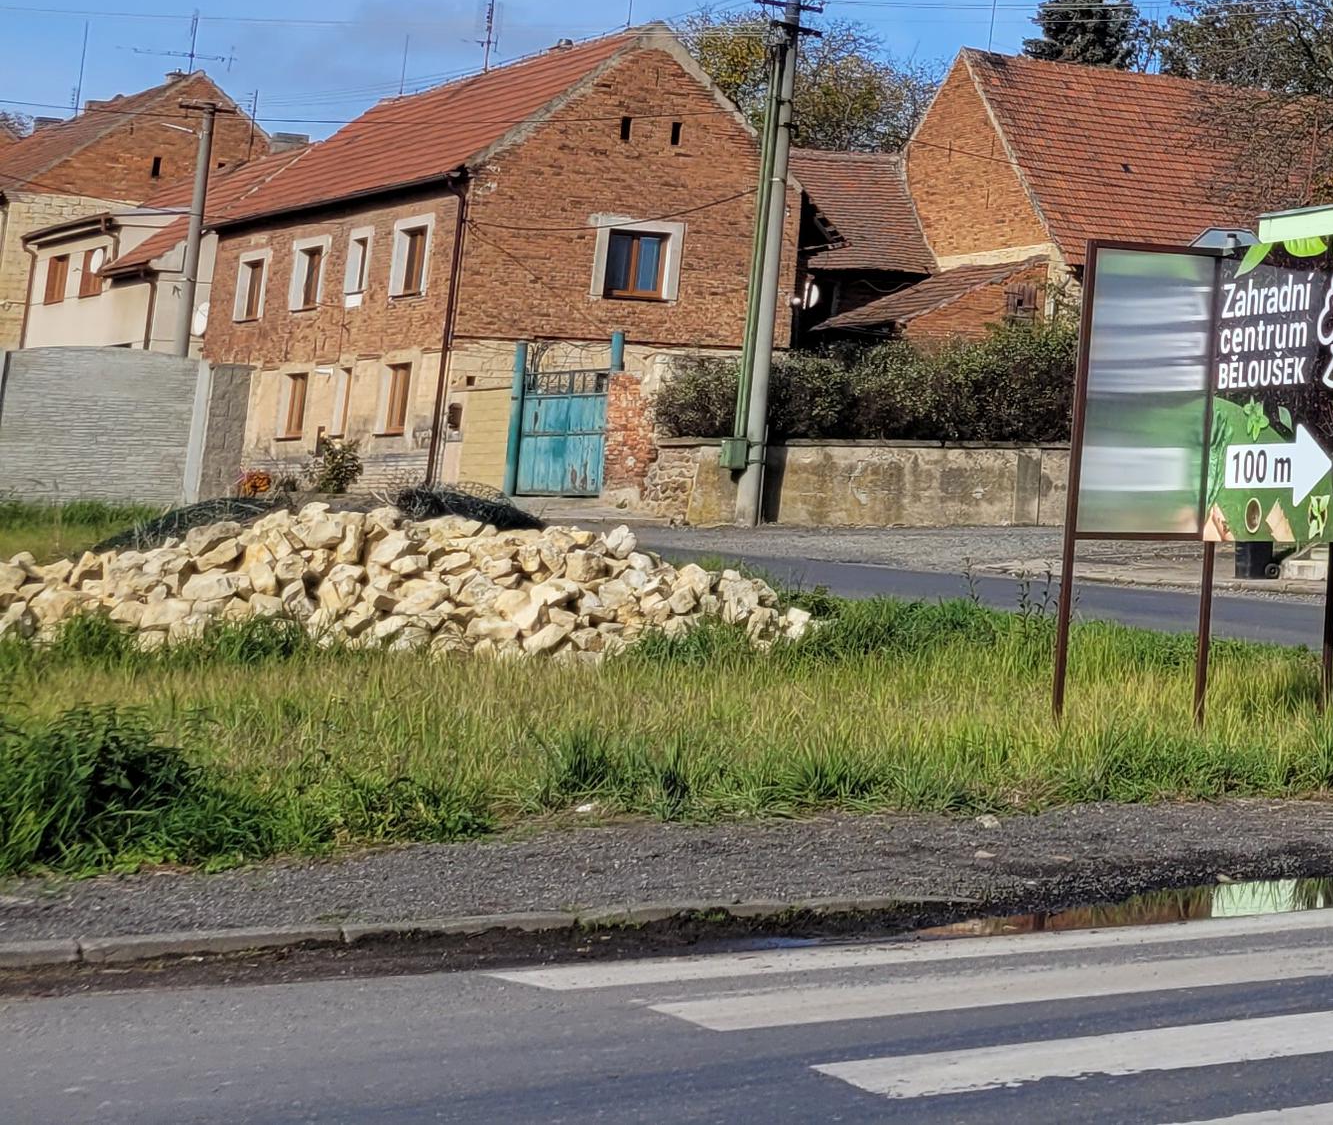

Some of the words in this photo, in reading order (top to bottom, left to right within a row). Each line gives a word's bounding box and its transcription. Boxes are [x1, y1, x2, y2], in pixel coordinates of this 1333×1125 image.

[1221, 272, 1315, 319] Zahradní
[1220, 320, 1308, 354] centrum
[1217, 350, 1307, 390] BĚLOUŠEK
[1233, 449, 1267, 484] 100
[1273, 456, 1292, 483] m
